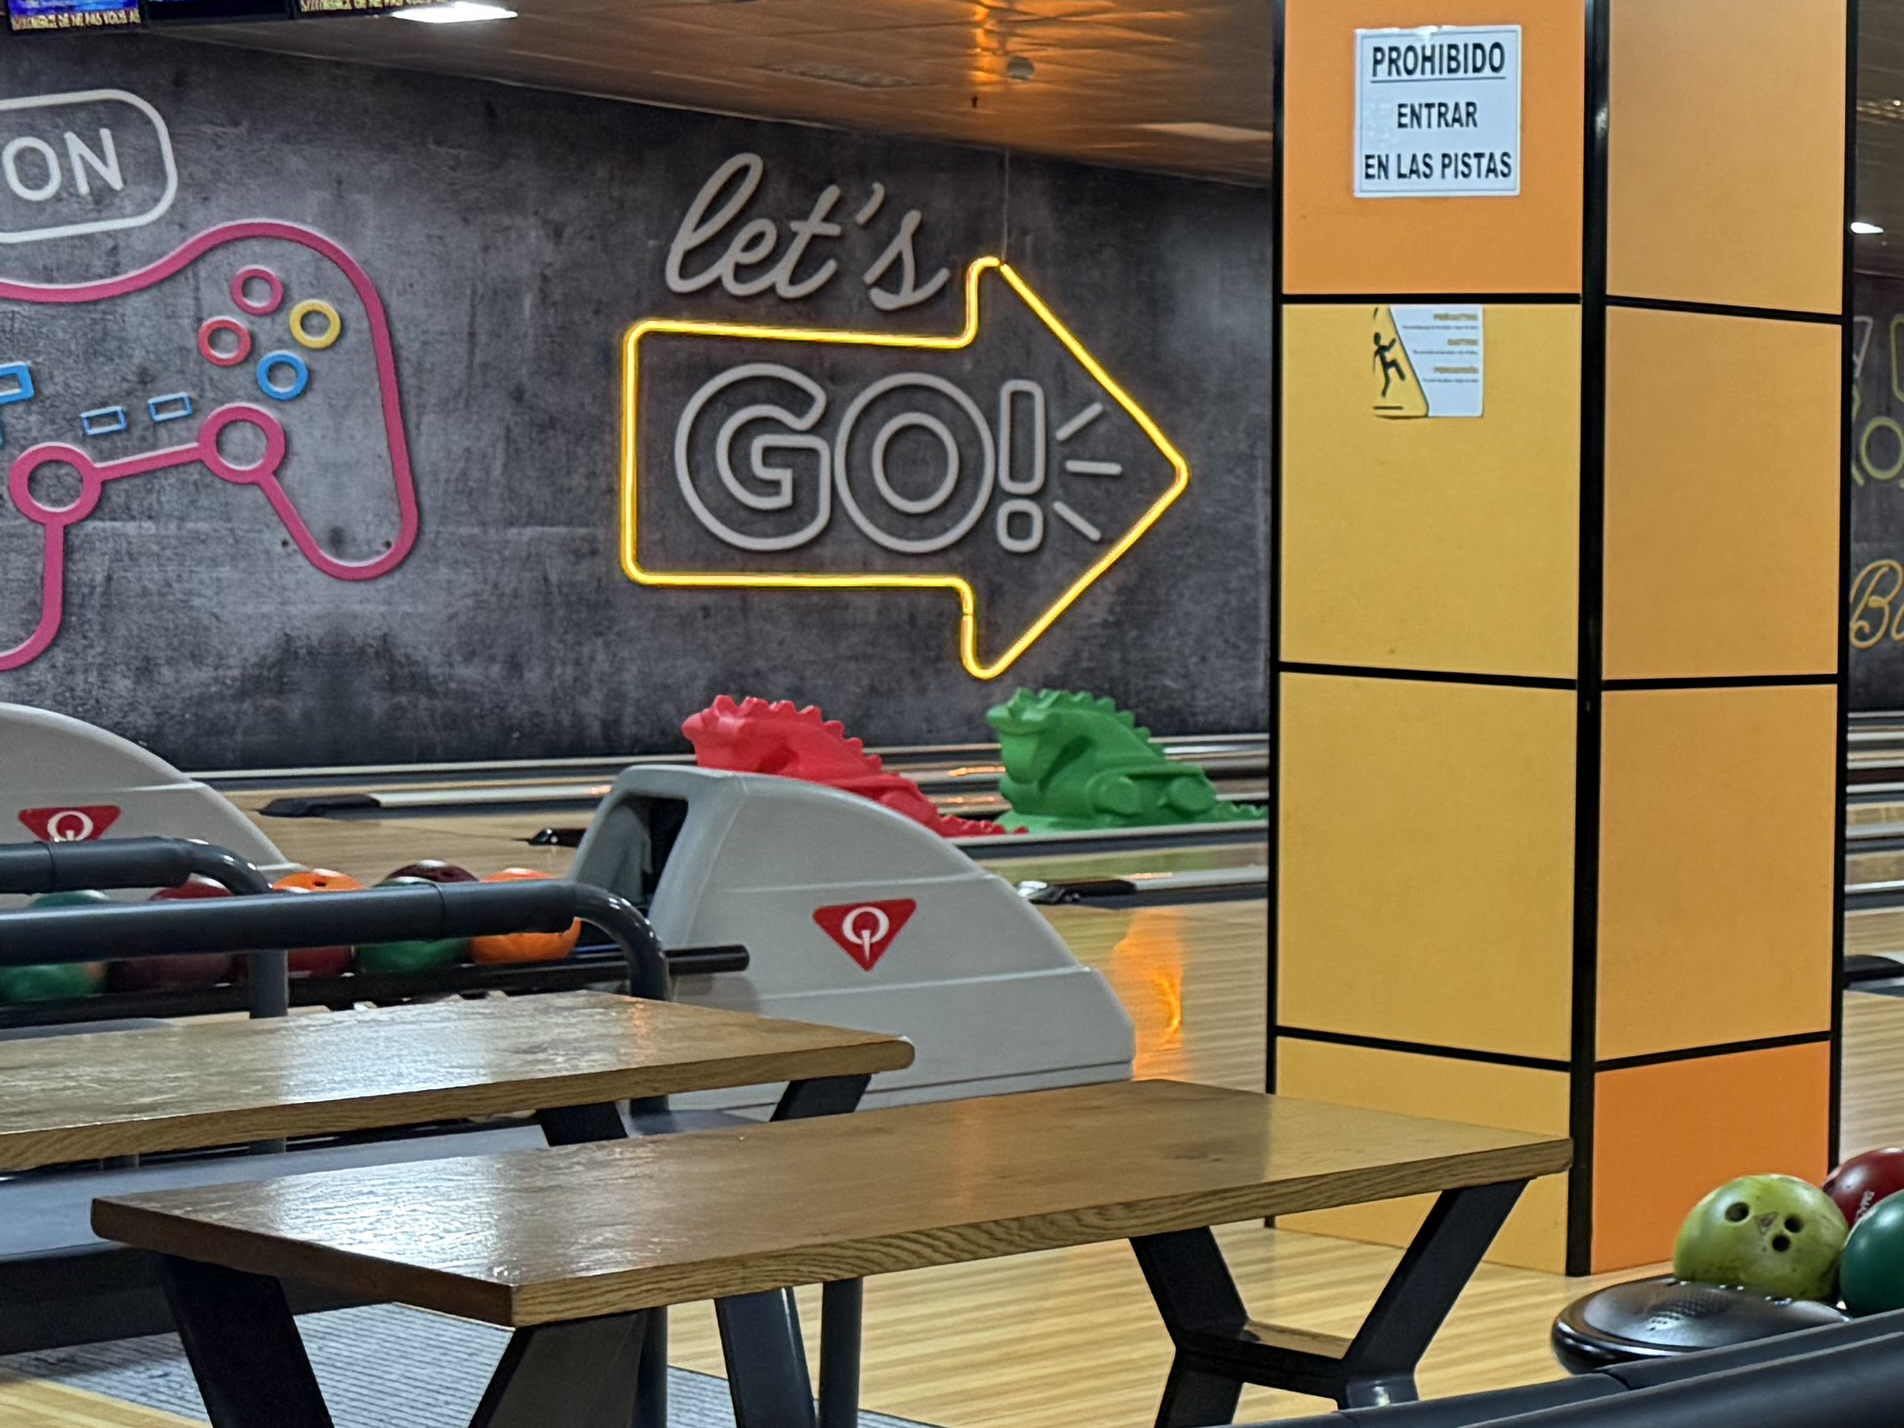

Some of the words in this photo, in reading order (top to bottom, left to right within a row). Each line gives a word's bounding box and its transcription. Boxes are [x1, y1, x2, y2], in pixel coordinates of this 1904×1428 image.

[1371, 42, 1506, 78] PROHIBIDO
[1396, 101, 1478, 130] ENTRAR
[2, 127, 124, 202] ON
[1364, 153, 1390, 181] EN
[1396, 152, 1434, 180] LAS
[1440, 151, 1513, 180] PISTAS
[664, 152, 949, 311] let's
[674, 362, 1046, 554] GO!
